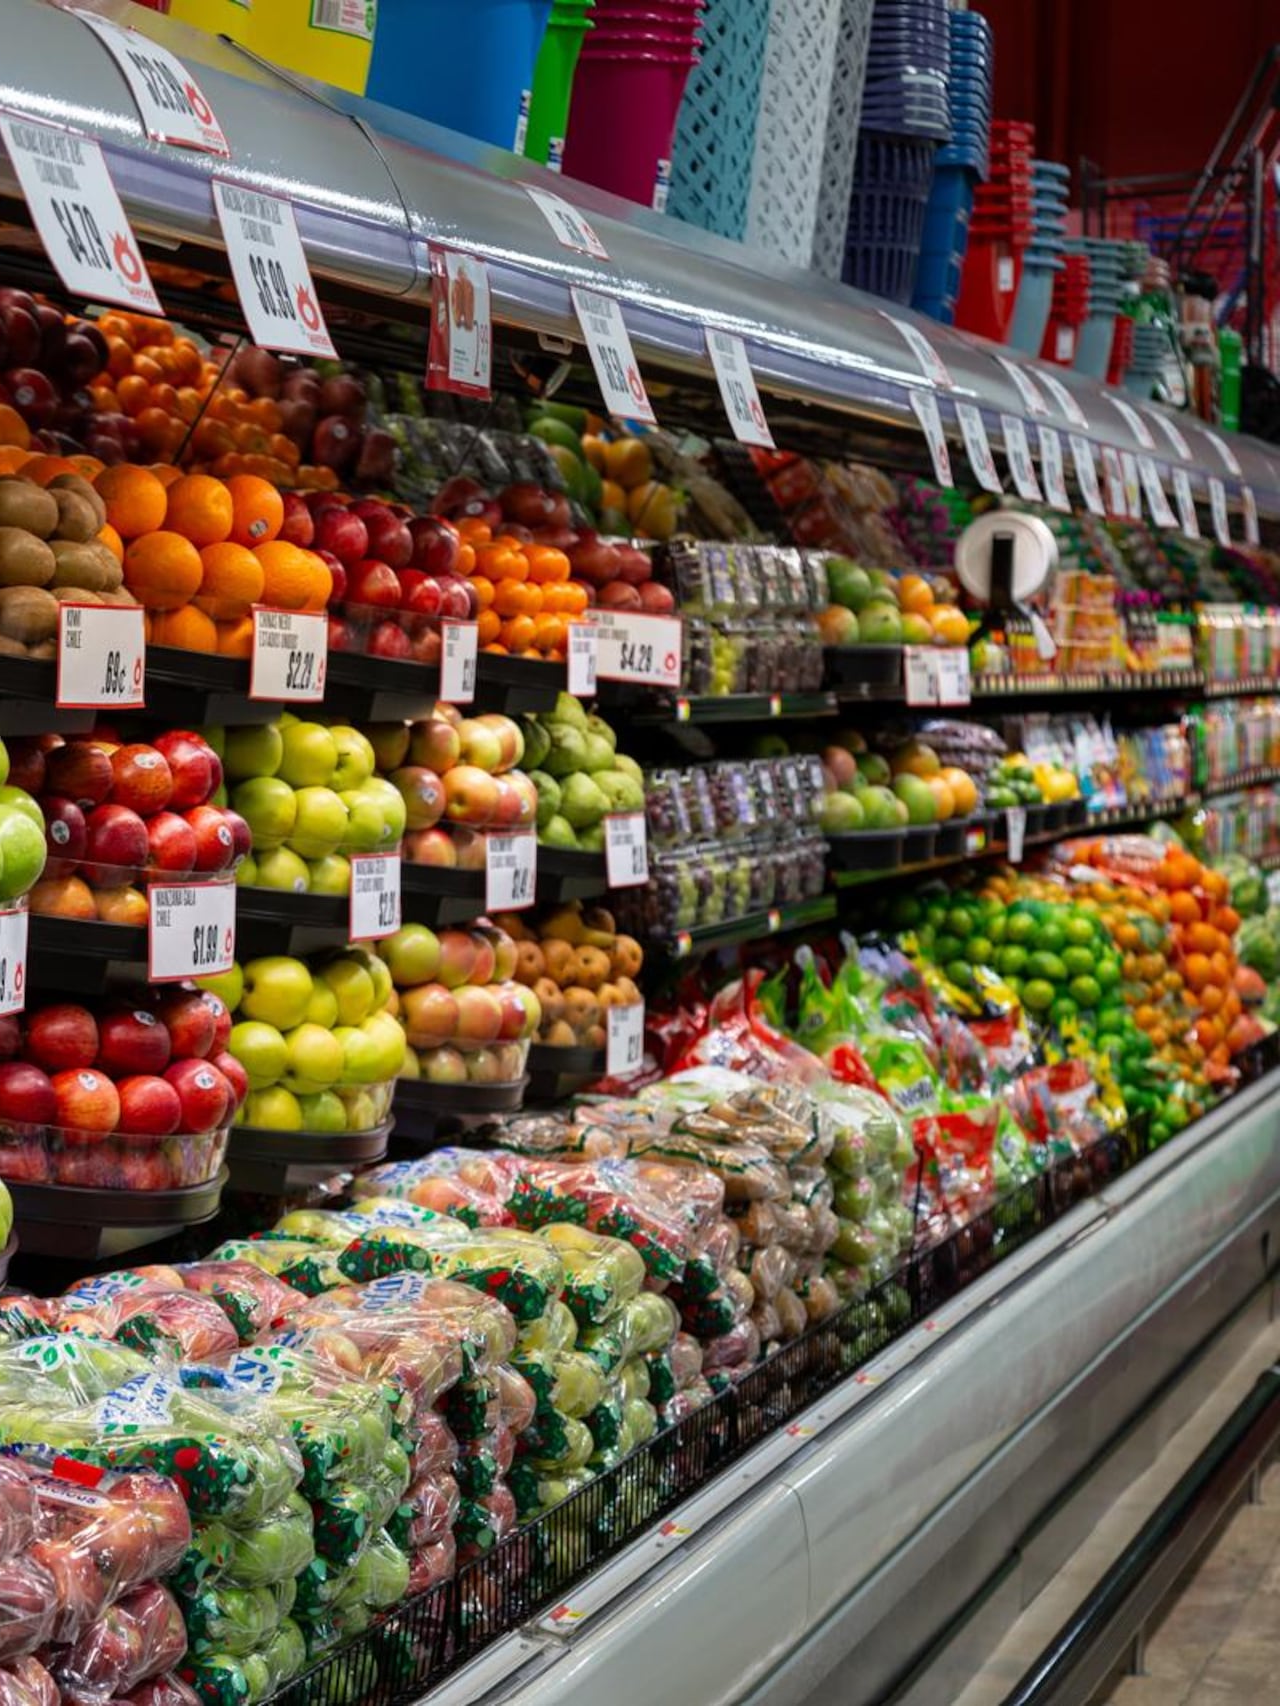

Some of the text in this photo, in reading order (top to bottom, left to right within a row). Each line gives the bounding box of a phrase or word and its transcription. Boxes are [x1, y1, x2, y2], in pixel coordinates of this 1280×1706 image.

[51, 196, 113, 271] $4.79
[249, 252, 296, 321] $6.99
[286, 651, 314, 689] $2.29
[620, 642, 653, 672] $4.29
[192, 925, 218, 966] $1.99
